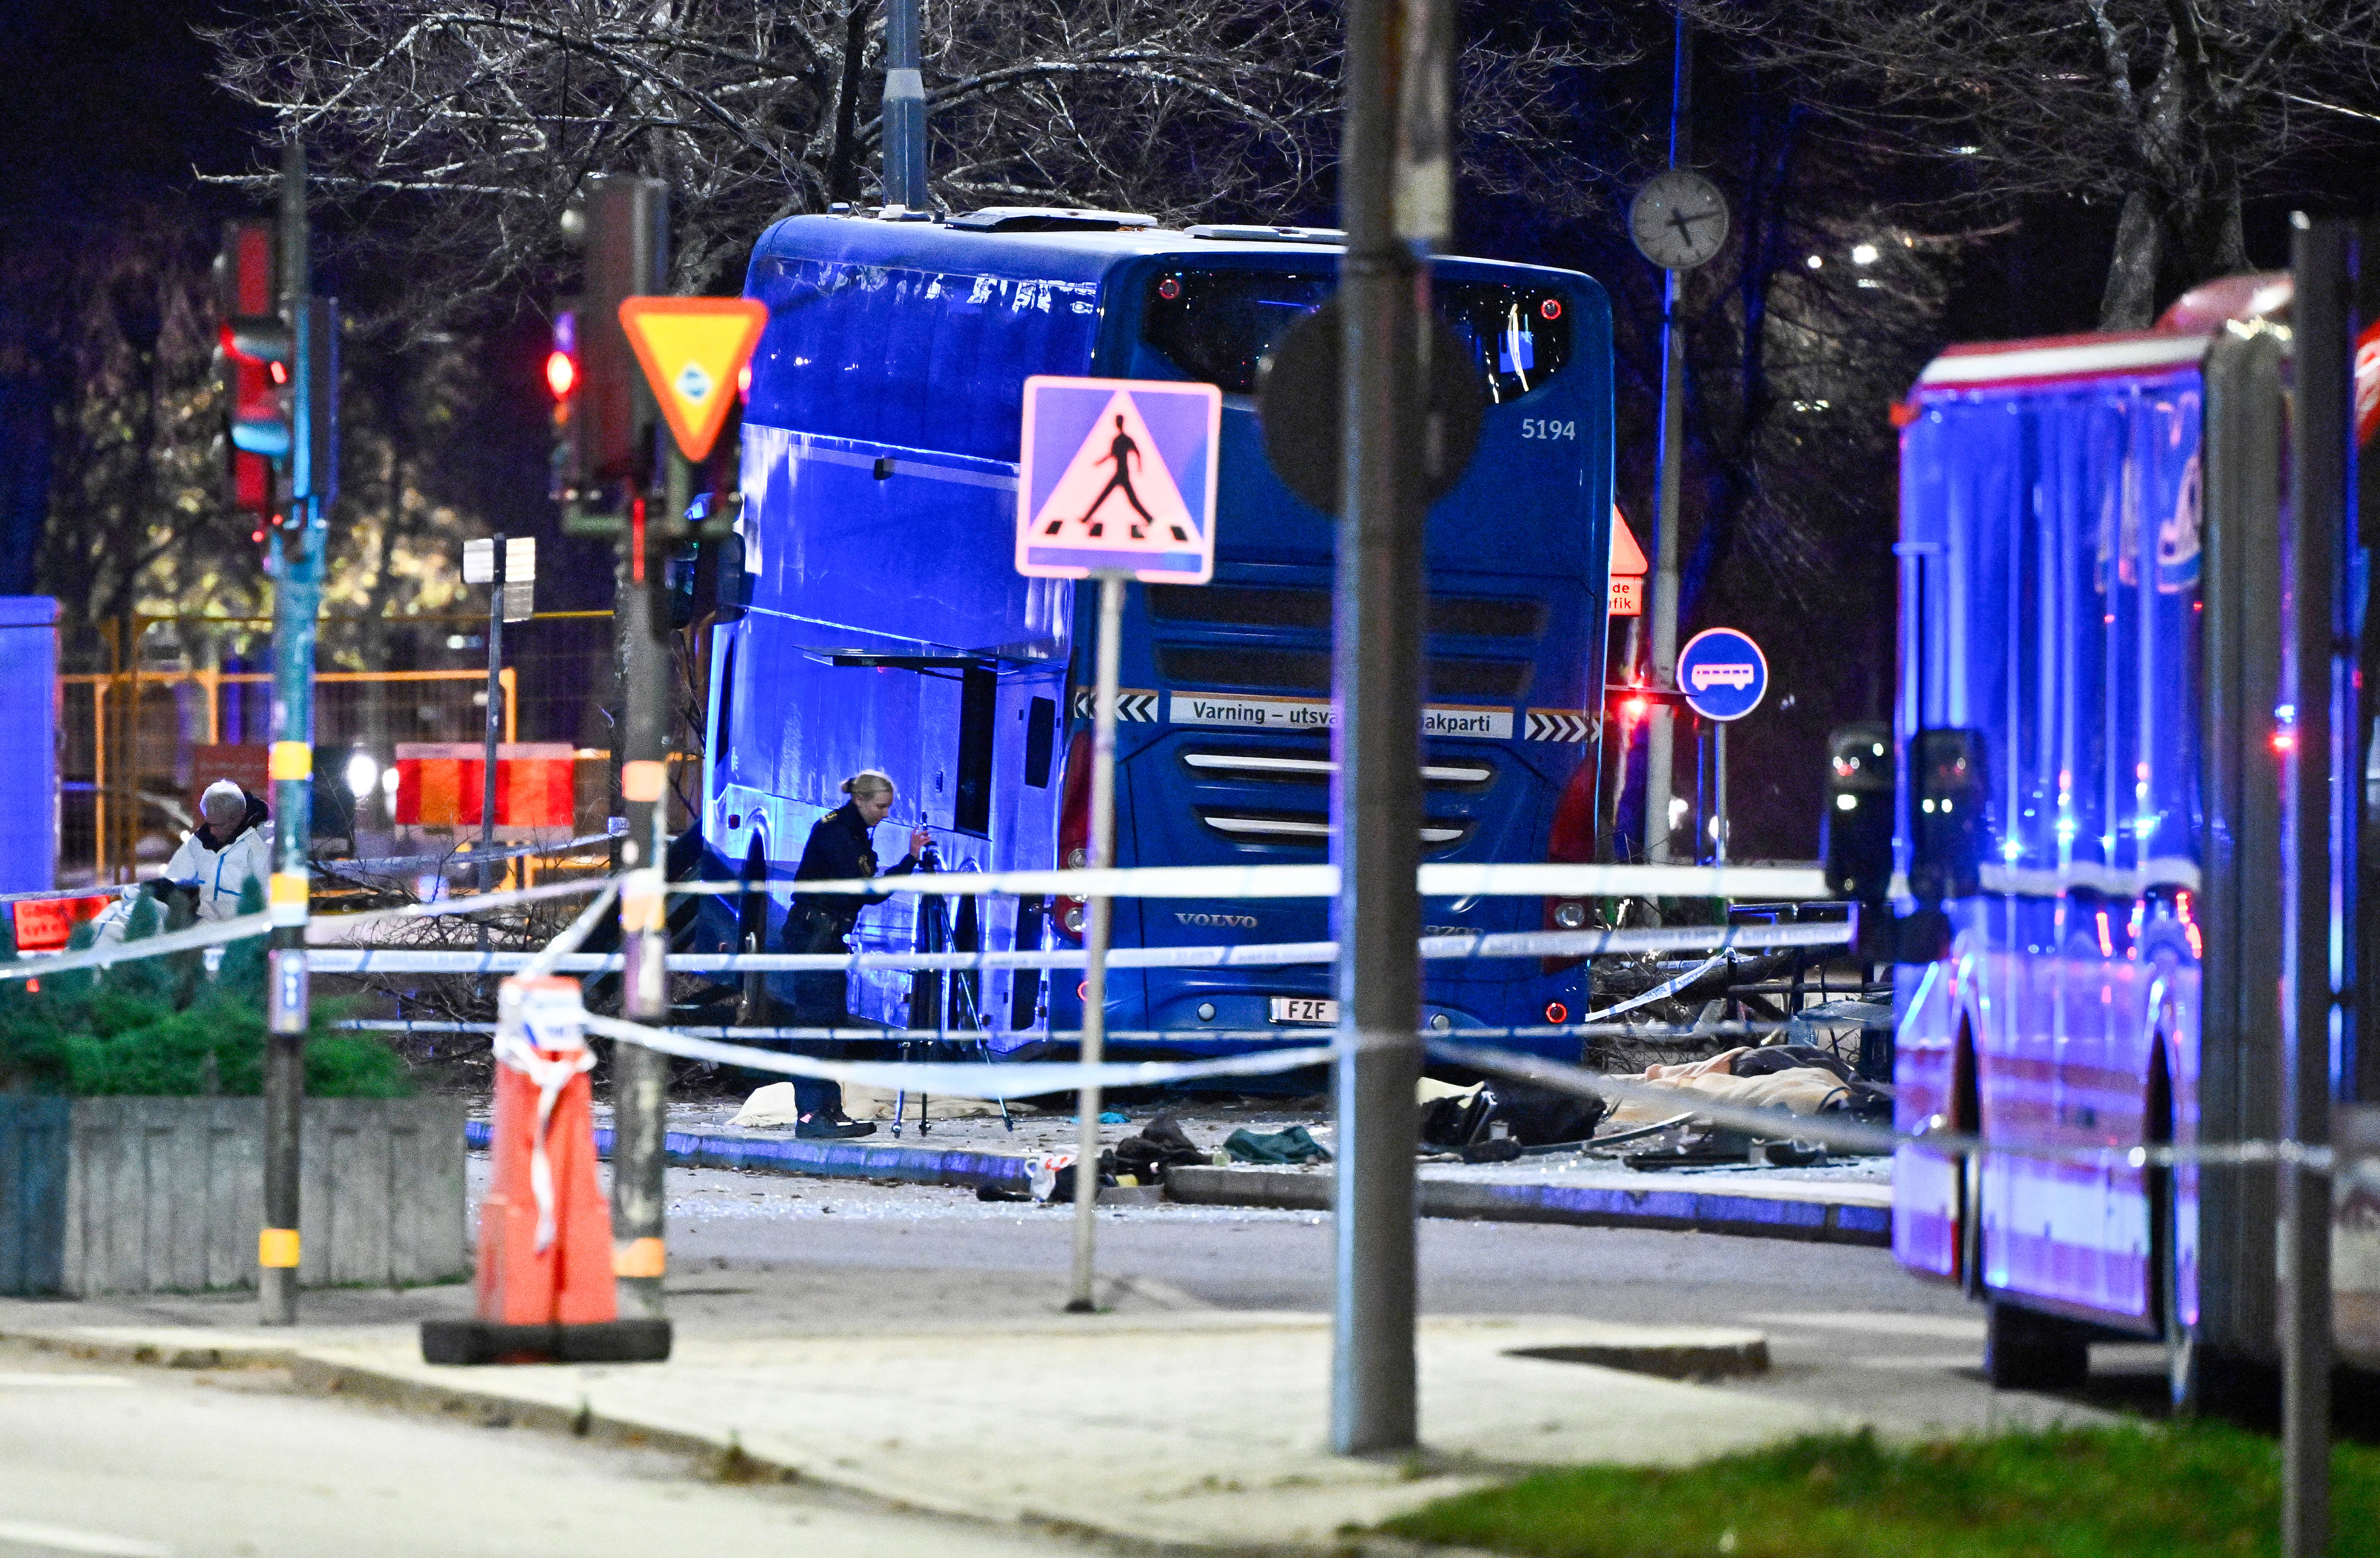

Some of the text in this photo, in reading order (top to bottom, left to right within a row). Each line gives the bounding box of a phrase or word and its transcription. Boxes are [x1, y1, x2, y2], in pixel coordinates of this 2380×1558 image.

[1521, 418, 1576, 440] 5194
[1609, 597, 1631, 609] fik
[1193, 701, 1265, 725] Varning
[1421, 713, 1490, 733] akparti
[1174, 913, 1258, 928] VOLVO
[1289, 1001, 1326, 1019] FZF
